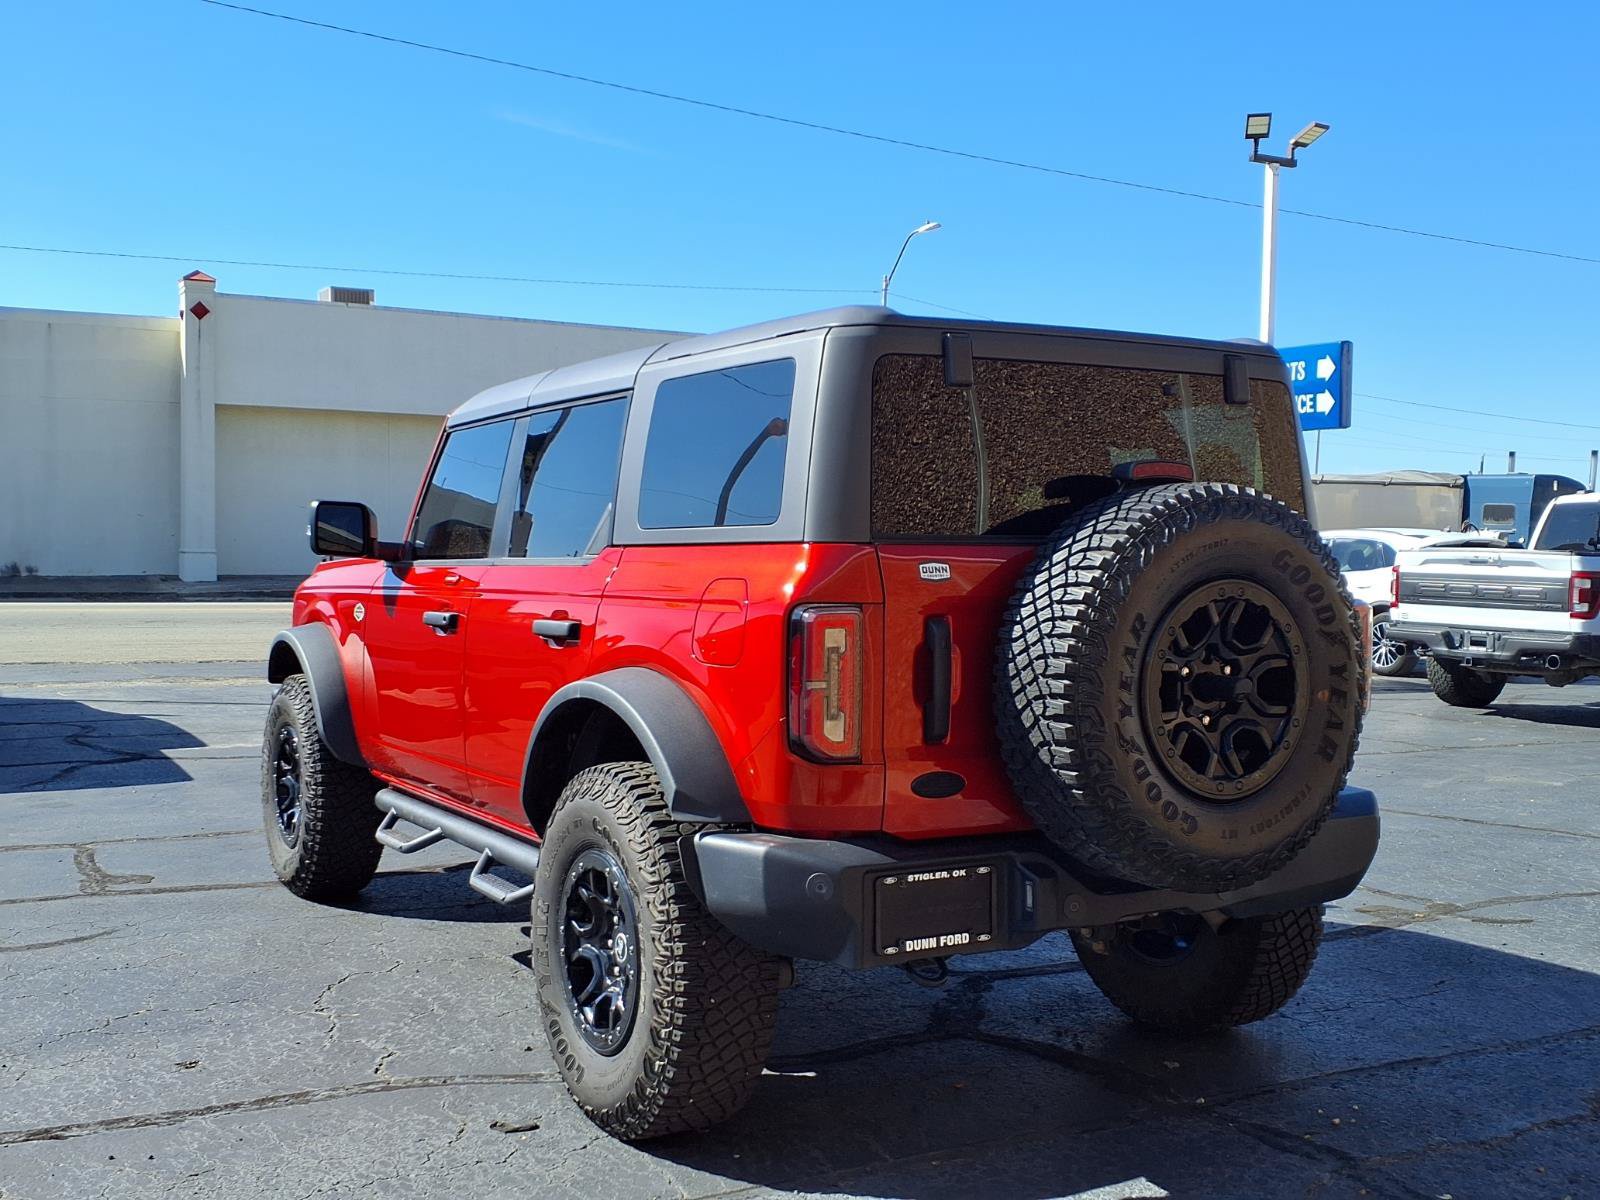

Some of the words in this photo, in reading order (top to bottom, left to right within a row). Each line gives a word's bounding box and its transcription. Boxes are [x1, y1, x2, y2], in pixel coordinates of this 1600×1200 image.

[1286, 360, 1306, 381] TS
[921, 565, 948, 574] DUNN
[907, 871, 950, 882] STIGLER,
[952, 869, 967, 877] OK
[905, 938, 937, 952] DUNN
[940, 933, 970, 947] FORD
